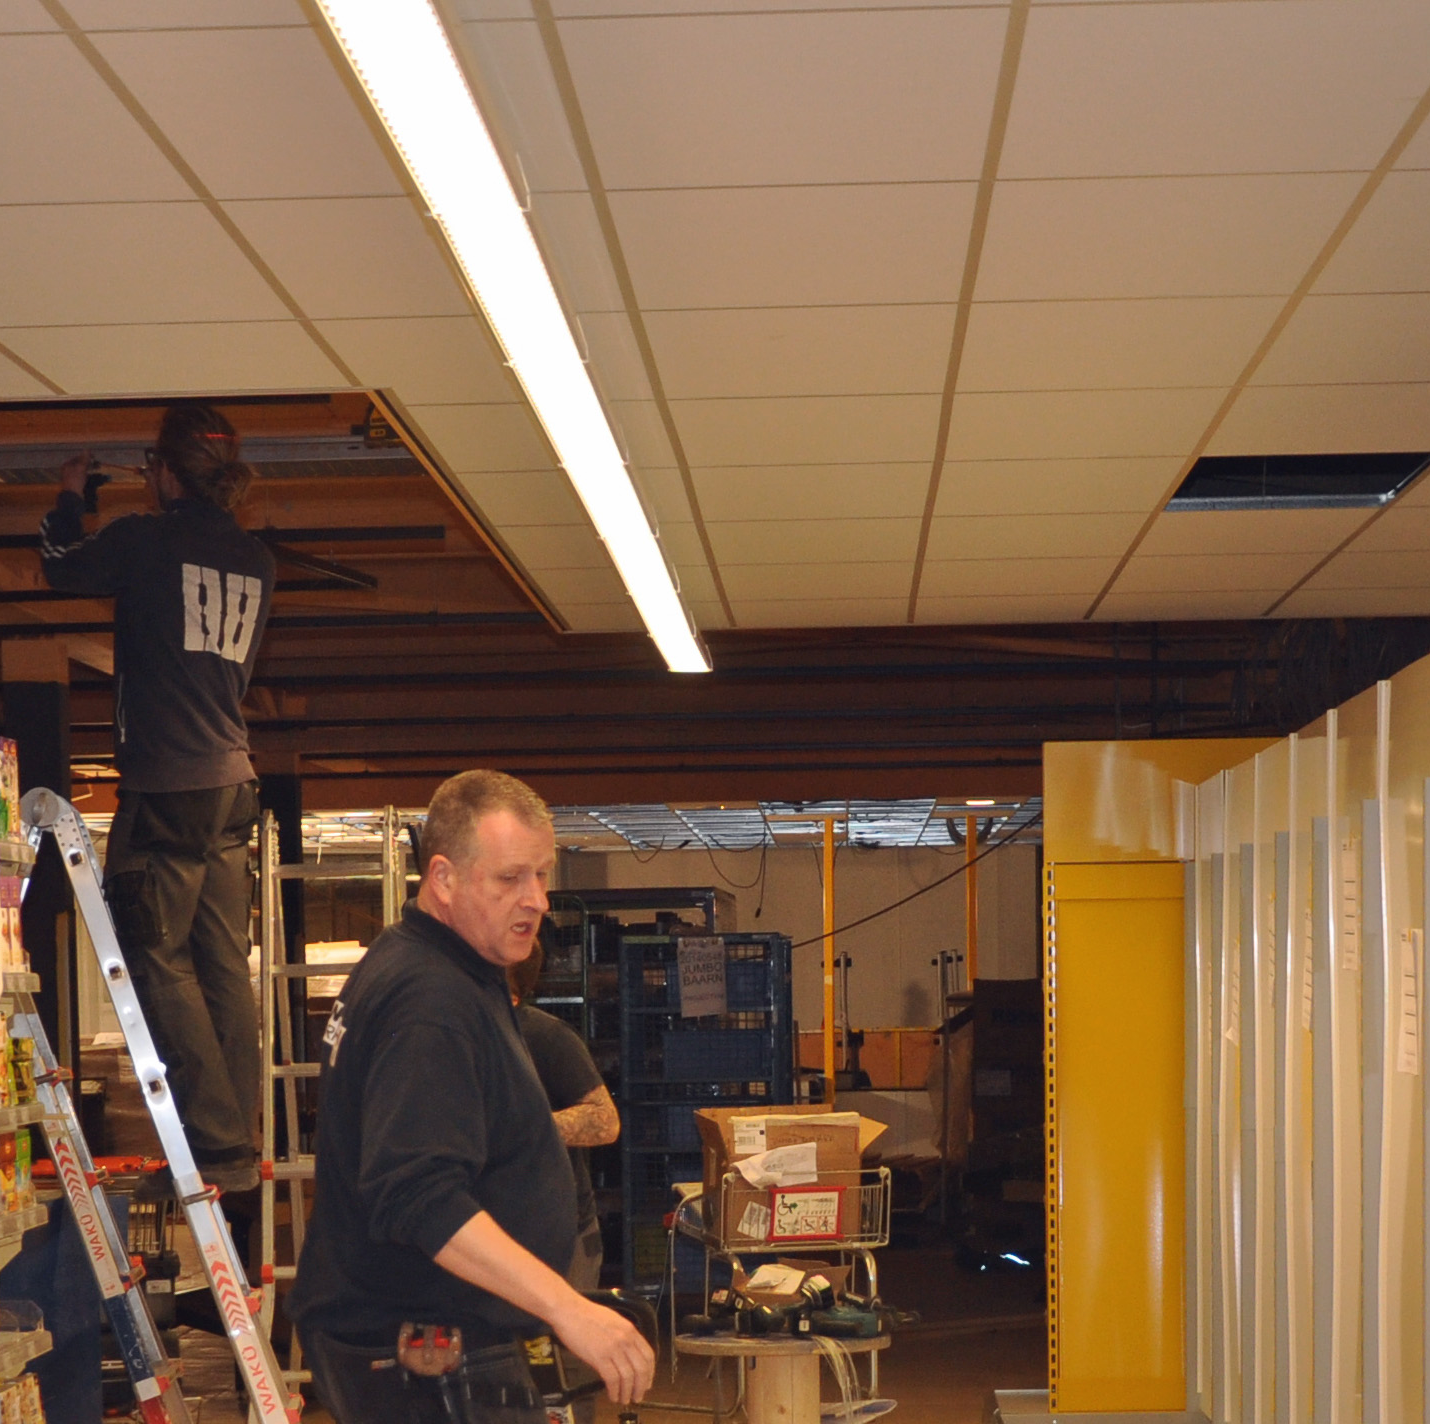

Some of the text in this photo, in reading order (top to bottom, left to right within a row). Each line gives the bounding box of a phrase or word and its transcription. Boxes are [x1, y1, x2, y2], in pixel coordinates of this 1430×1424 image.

[682, 961, 723, 975] JUMBO
[682, 973, 723, 986] BAARN
[81, 1212, 105, 1264] WAKÜ
[240, 1344, 278, 1418] WAKÜ
